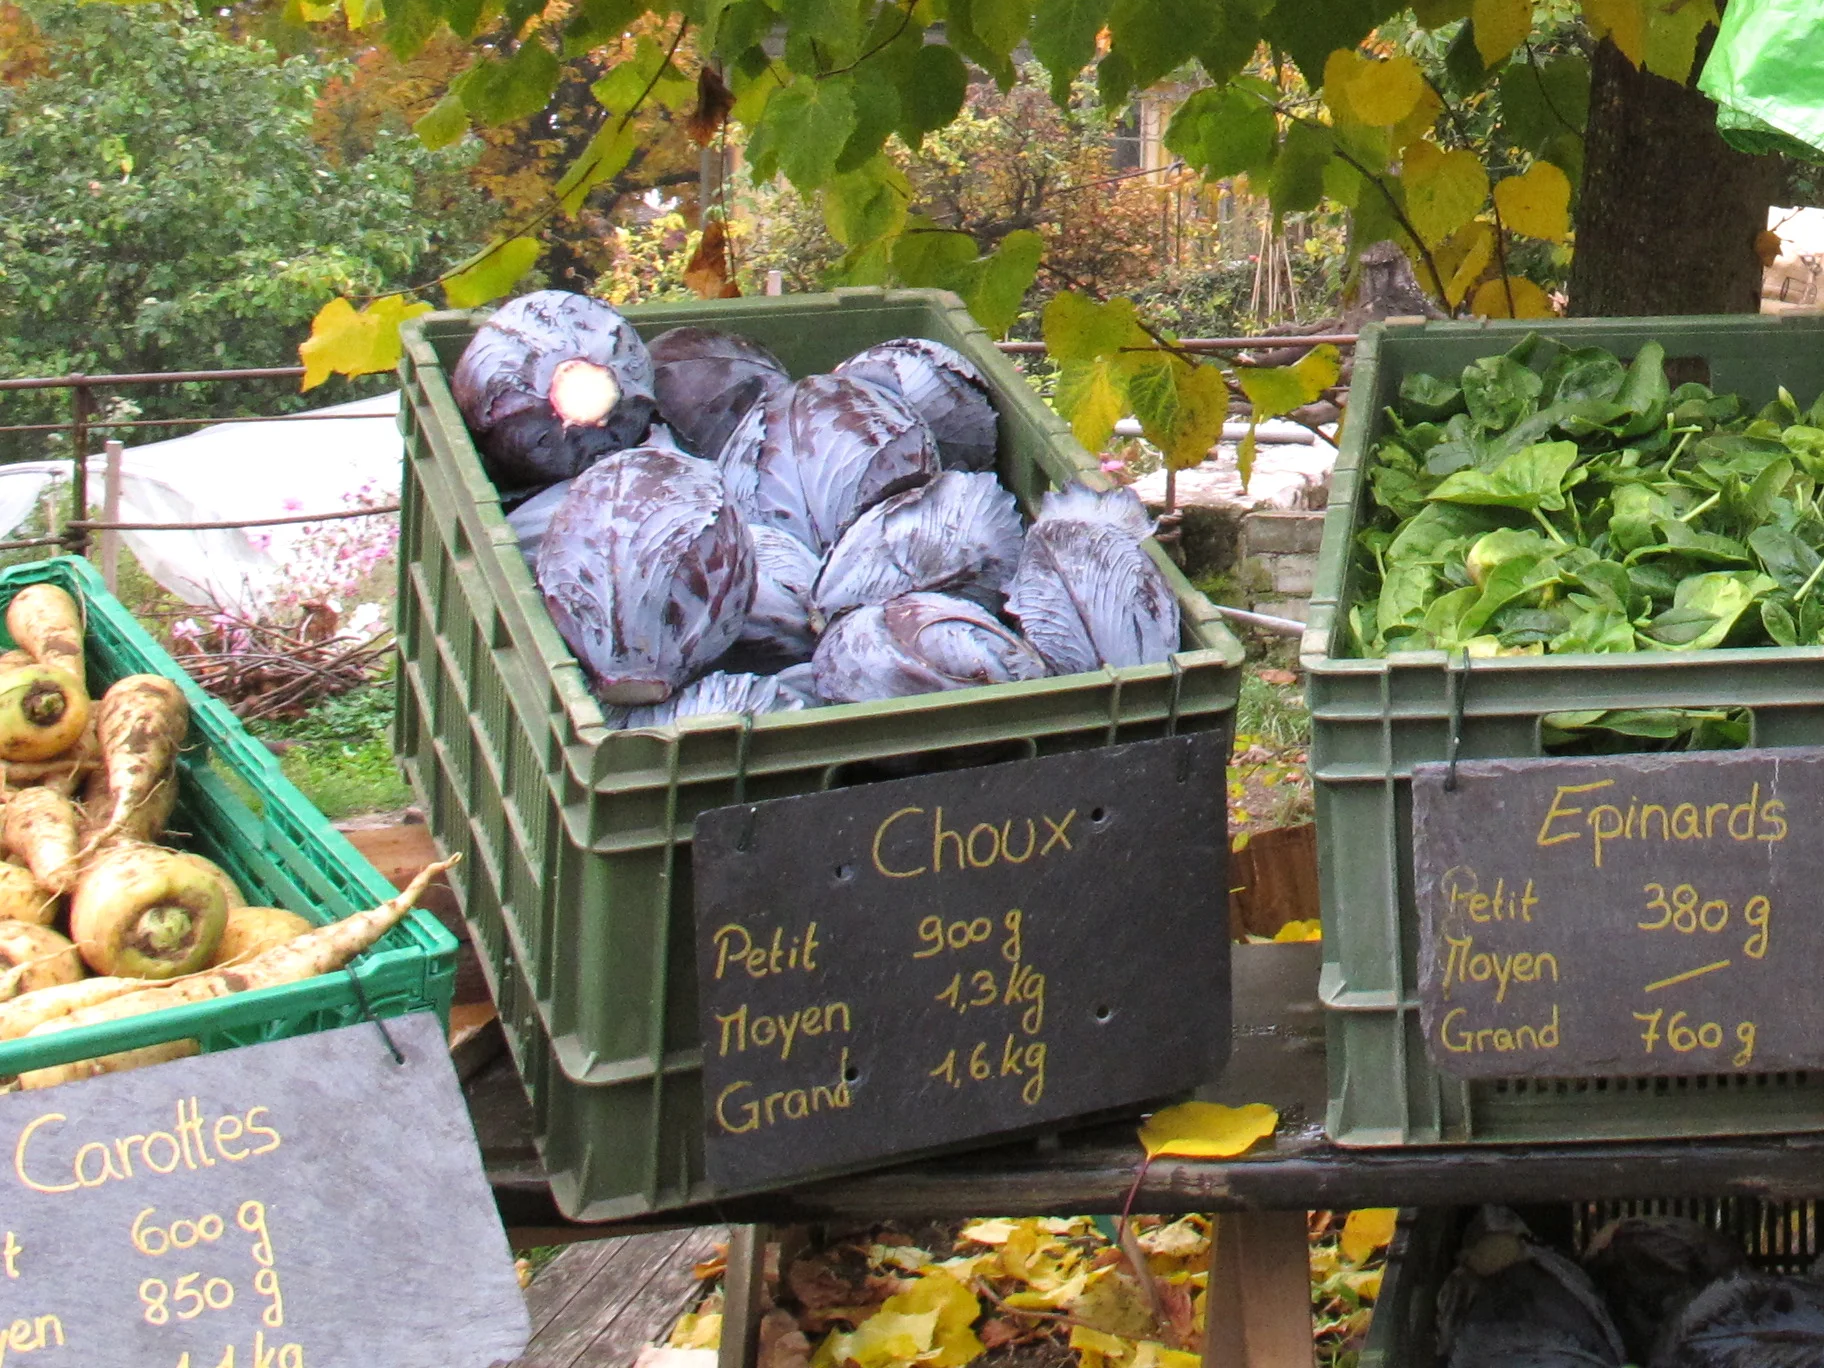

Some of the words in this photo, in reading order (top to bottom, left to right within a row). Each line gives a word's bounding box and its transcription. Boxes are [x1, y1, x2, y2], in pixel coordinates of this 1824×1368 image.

[872, 806, 1076, 879] Choux
[1537, 779, 1788, 868] Epinards
[713, 921, 819, 979] Petit
[913, 915, 993, 959] 900
[1442, 865, 1539, 924] Petit
[1638, 883, 1729, 933] 380
[1744, 895, 1771, 959] g
[1441, 1005, 1560, 1053] Grand
[1633, 1009, 1723, 1053] 760
[1735, 1021, 1757, 1067] g
[716, 1048, 851, 1134] Grand
[14, 1096, 281, 1192] Carottes
[131, 1208, 224, 1256] 600
[236, 1200, 273, 1266] g
[139, 1272, 234, 1325] 850
[254, 1268, 283, 1328] g
